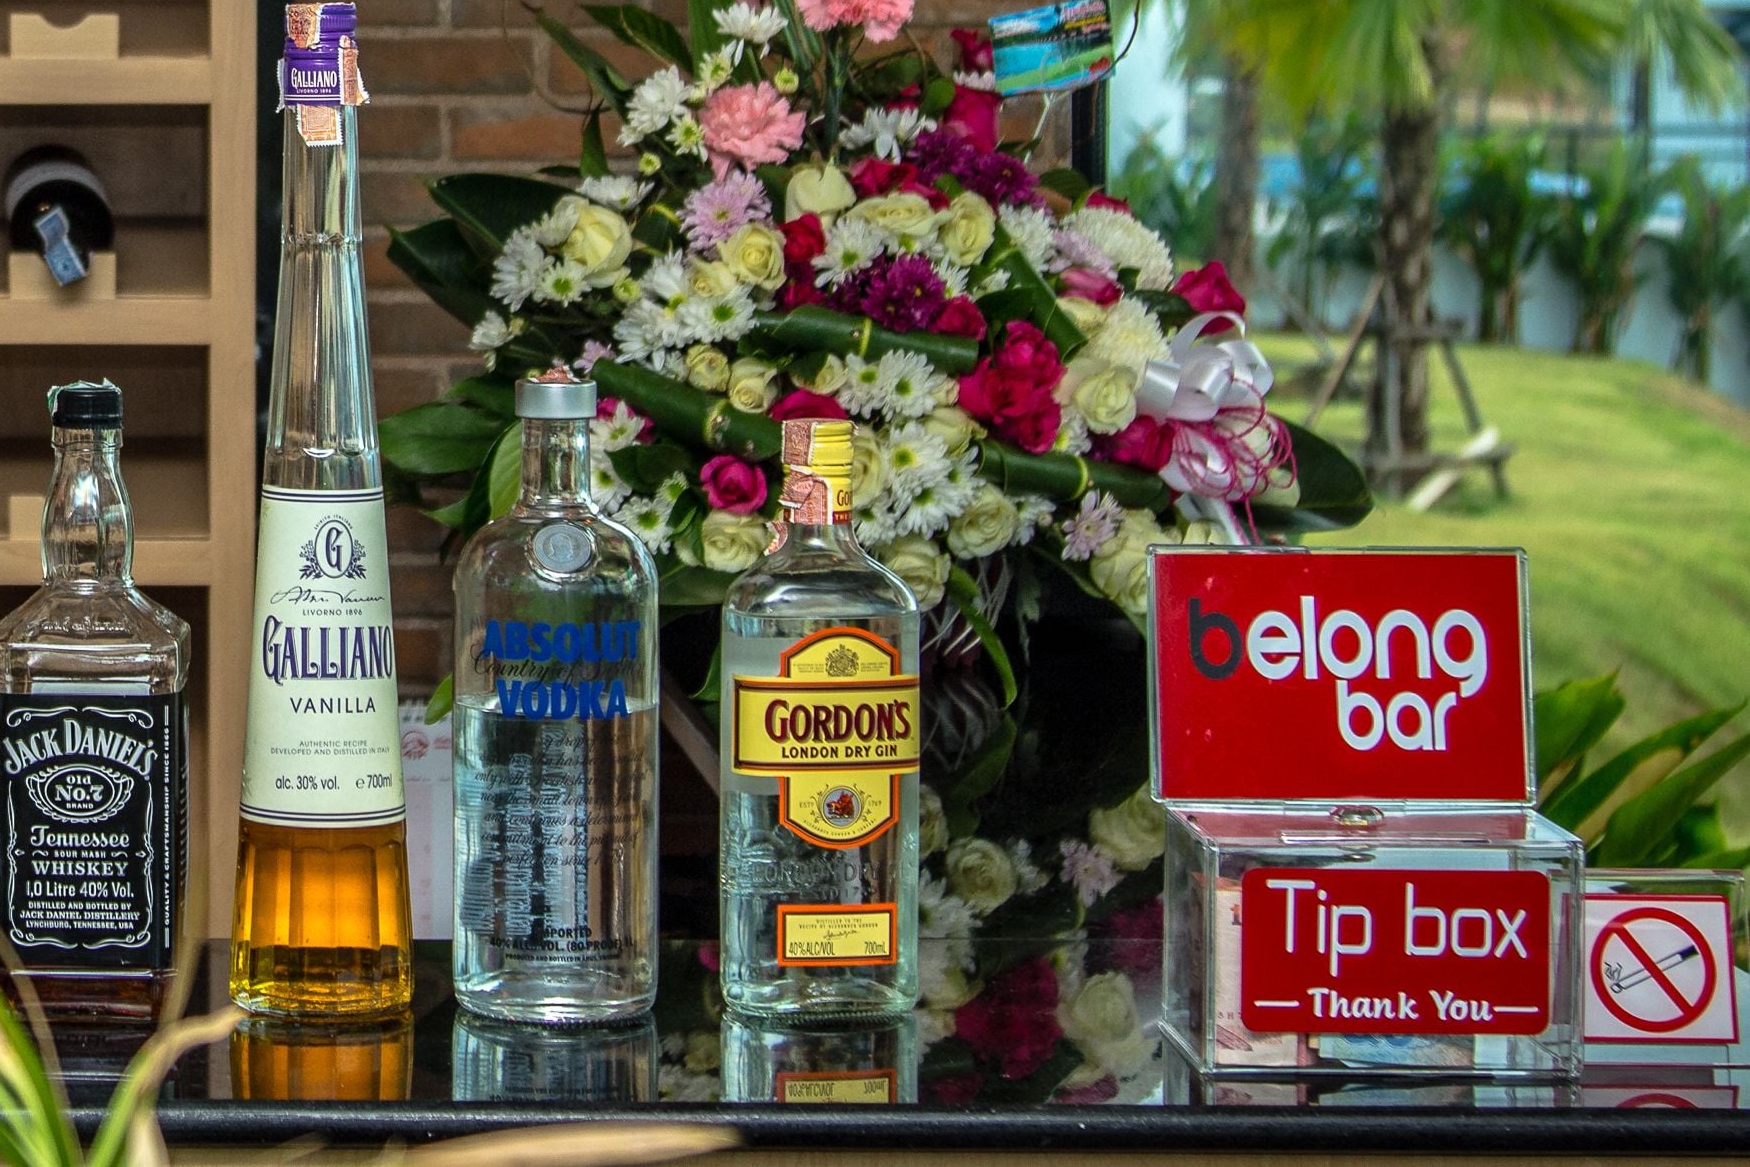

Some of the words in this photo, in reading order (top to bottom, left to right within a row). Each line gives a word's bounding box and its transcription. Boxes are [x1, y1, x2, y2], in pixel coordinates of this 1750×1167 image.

[291, 68, 337, 88] GALLIANO
[325, 527, 343, 572] G
[346, 608, 363, 616] 1896
[262, 614, 394, 685] GALLIANO
[482, 619, 641, 663] ABSOLUT
[1188, 595, 1489, 698] belong
[290, 697, 376, 714] VANILLA
[496, 679, 630, 721] VODKA
[764, 698, 912, 744] GORDON'S
[1336, 680, 1460, 751] bar
[2, 728, 63, 775] JACK
[63, 718, 159, 777] DANIEL'S
[271, 747, 311, 755] DEVELOPED
[299, 740, 341, 748] AUTHENTIC
[343, 739, 367, 747] RECIPE
[782, 746, 839, 758] LONDON
[845, 746, 871, 758] DRY
[875, 744, 898, 757] GIN
[66, 775, 91, 785] Old
[275, 775, 294, 790] alc.
[296, 775, 318, 790] 30%
[320, 776, 340, 790] vol.
[366, 773, 393, 788] 700ml
[30, 825, 130, 848] Tennessee
[54, 850, 78, 858] SOUR
[81, 850, 107, 858] MASH
[31, 860, 129, 877] WHISKEY
[46, 881, 76, 897] Litre
[80, 881, 108, 897] 40%
[111, 881, 134, 898] Vol.
[28, 901, 66, 909] DISTILLED
[86, 902, 119, 910] BOTTLED
[20, 910, 44, 919] JACK
[46, 911, 82, 919] DANIEL
[84, 911, 140, 920] DISTILLERY
[119, 921, 134, 929] USA
[1265, 879, 1372, 977] Tip
[1404, 882, 1528, 959] box
[864, 941, 887, 954] 700mL
[1306, 987, 1420, 1021] Thank
[1428, 989, 1494, 1022] You
